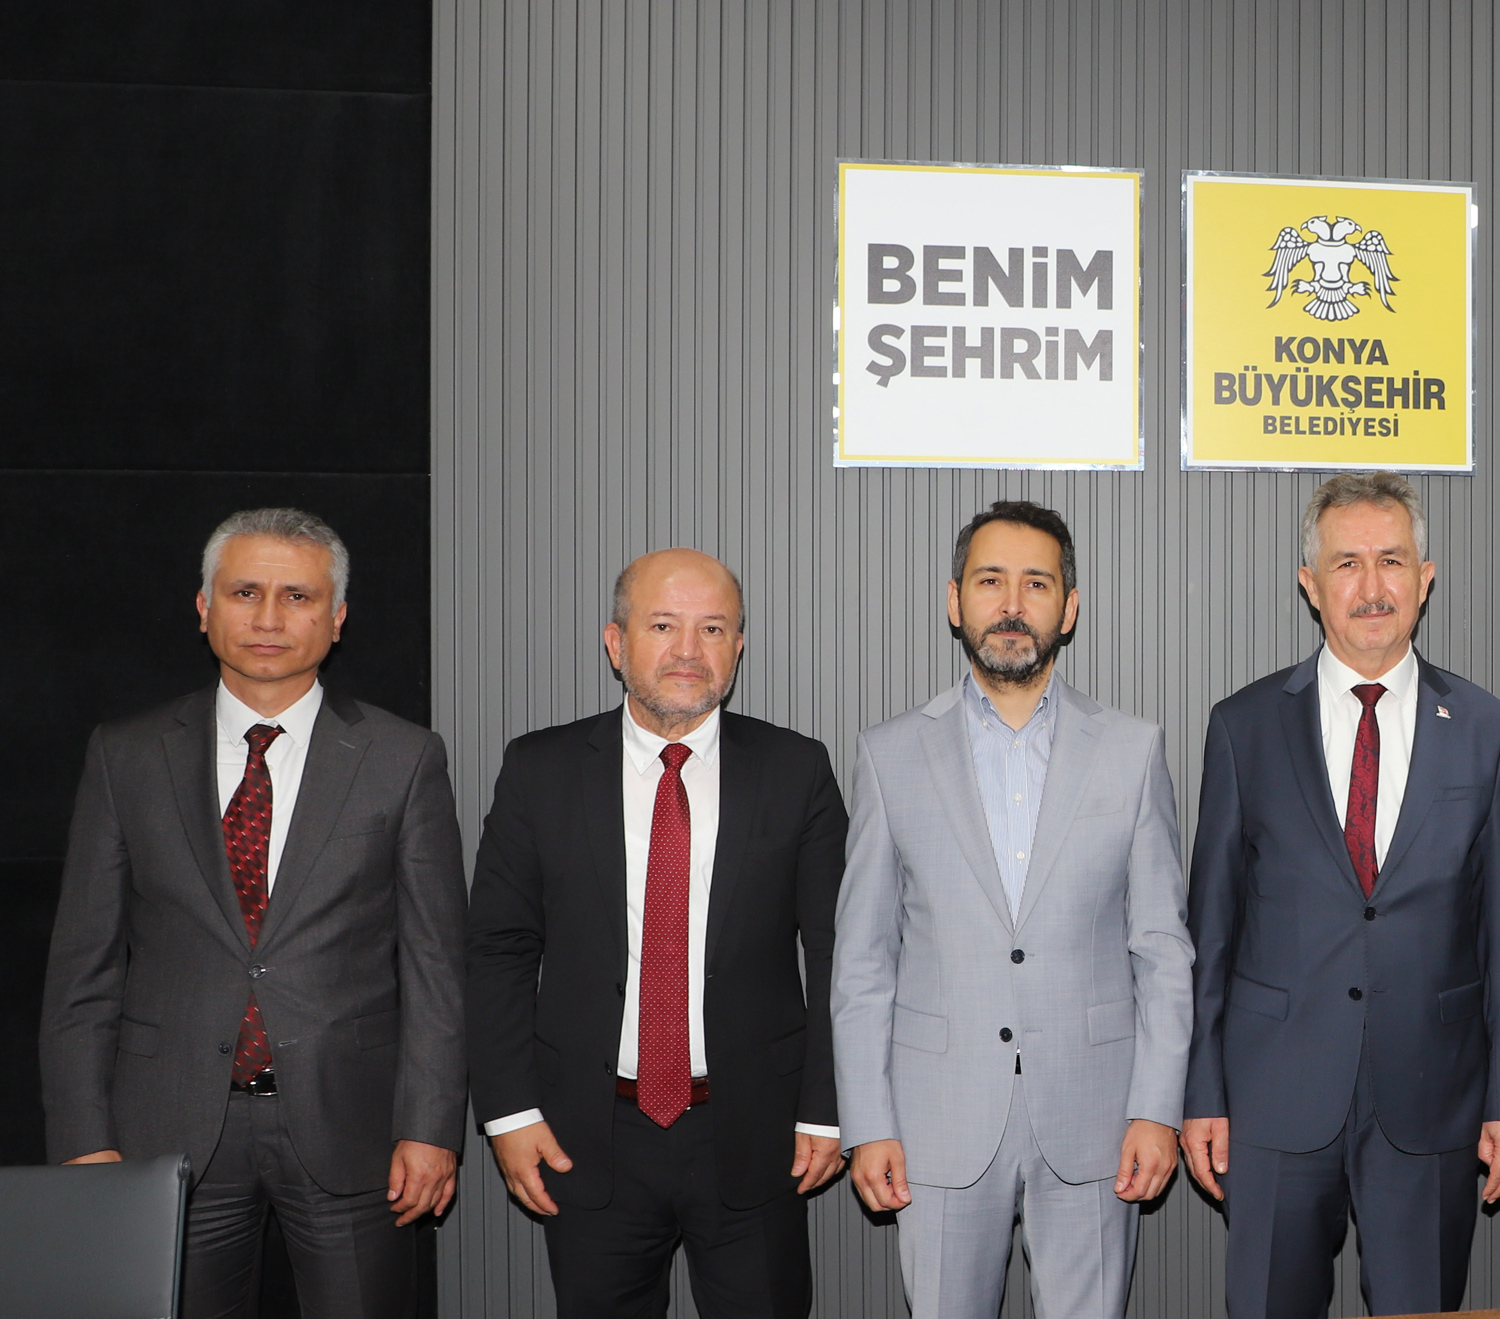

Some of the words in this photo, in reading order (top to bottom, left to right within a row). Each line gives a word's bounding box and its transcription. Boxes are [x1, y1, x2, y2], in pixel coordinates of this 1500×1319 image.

[1274, 336, 1389, 366] KONYA
[1213, 365, 1446, 413] BÜYÜKŞEHİR
[1263, 412, 1399, 438] BELEDİYESİ
